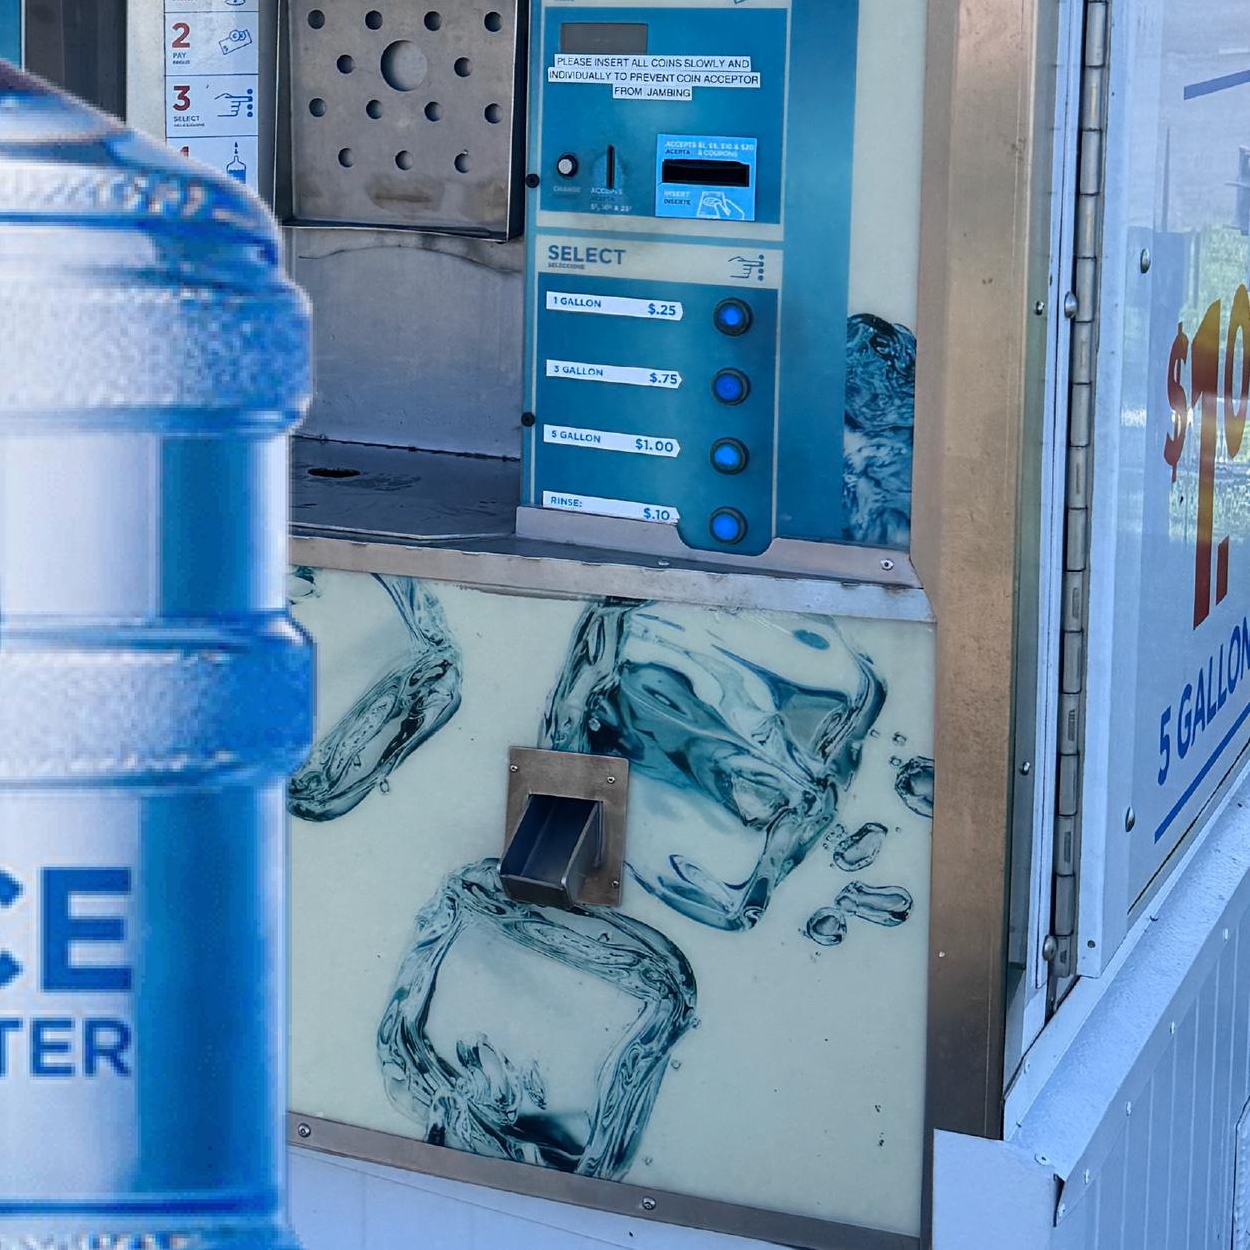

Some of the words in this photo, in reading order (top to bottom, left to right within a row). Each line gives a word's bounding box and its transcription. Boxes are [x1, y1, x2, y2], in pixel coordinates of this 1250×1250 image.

[172, 22, 190, 48] 2
[557, 58, 592, 66] PLEASE
[595, 58, 628, 67] INSERT
[632, 59, 648, 67] ALL
[651, 59, 682, 68] COINS
[684, 59, 725, 68] SLOWLY
[728, 59, 749, 68] AND
[550, 71, 611, 80] INDIVIDUALLY
[614, 72, 627, 81] TO
[630, 73, 674, 82] PREVENT
[677, 74, 700, 83] COIN
[704, 75, 759, 84] ACCEPTOR
[173, 86, 190, 111] 3
[614, 87, 642, 95] FROM
[647, 88, 690, 97] JAMBING
[548, 245, 626, 264] SELECT
[554, 297, 557, 305] 1
[560, 297, 601, 308] GALLON
[648, 303, 676, 316] $.25
[554, 365, 559, 373] 3
[563, 366, 603, 376] GALLON
[649, 373, 677, 384] $.75
[552, 430, 557, 438] 5
[560, 431, 600, 444] GALLON
[635, 439, 673, 452] $1.00
[551, 497, 582, 507] RINSE:
[643, 508, 670, 521] $.10
[1158, 705, 1171, 786] 5
